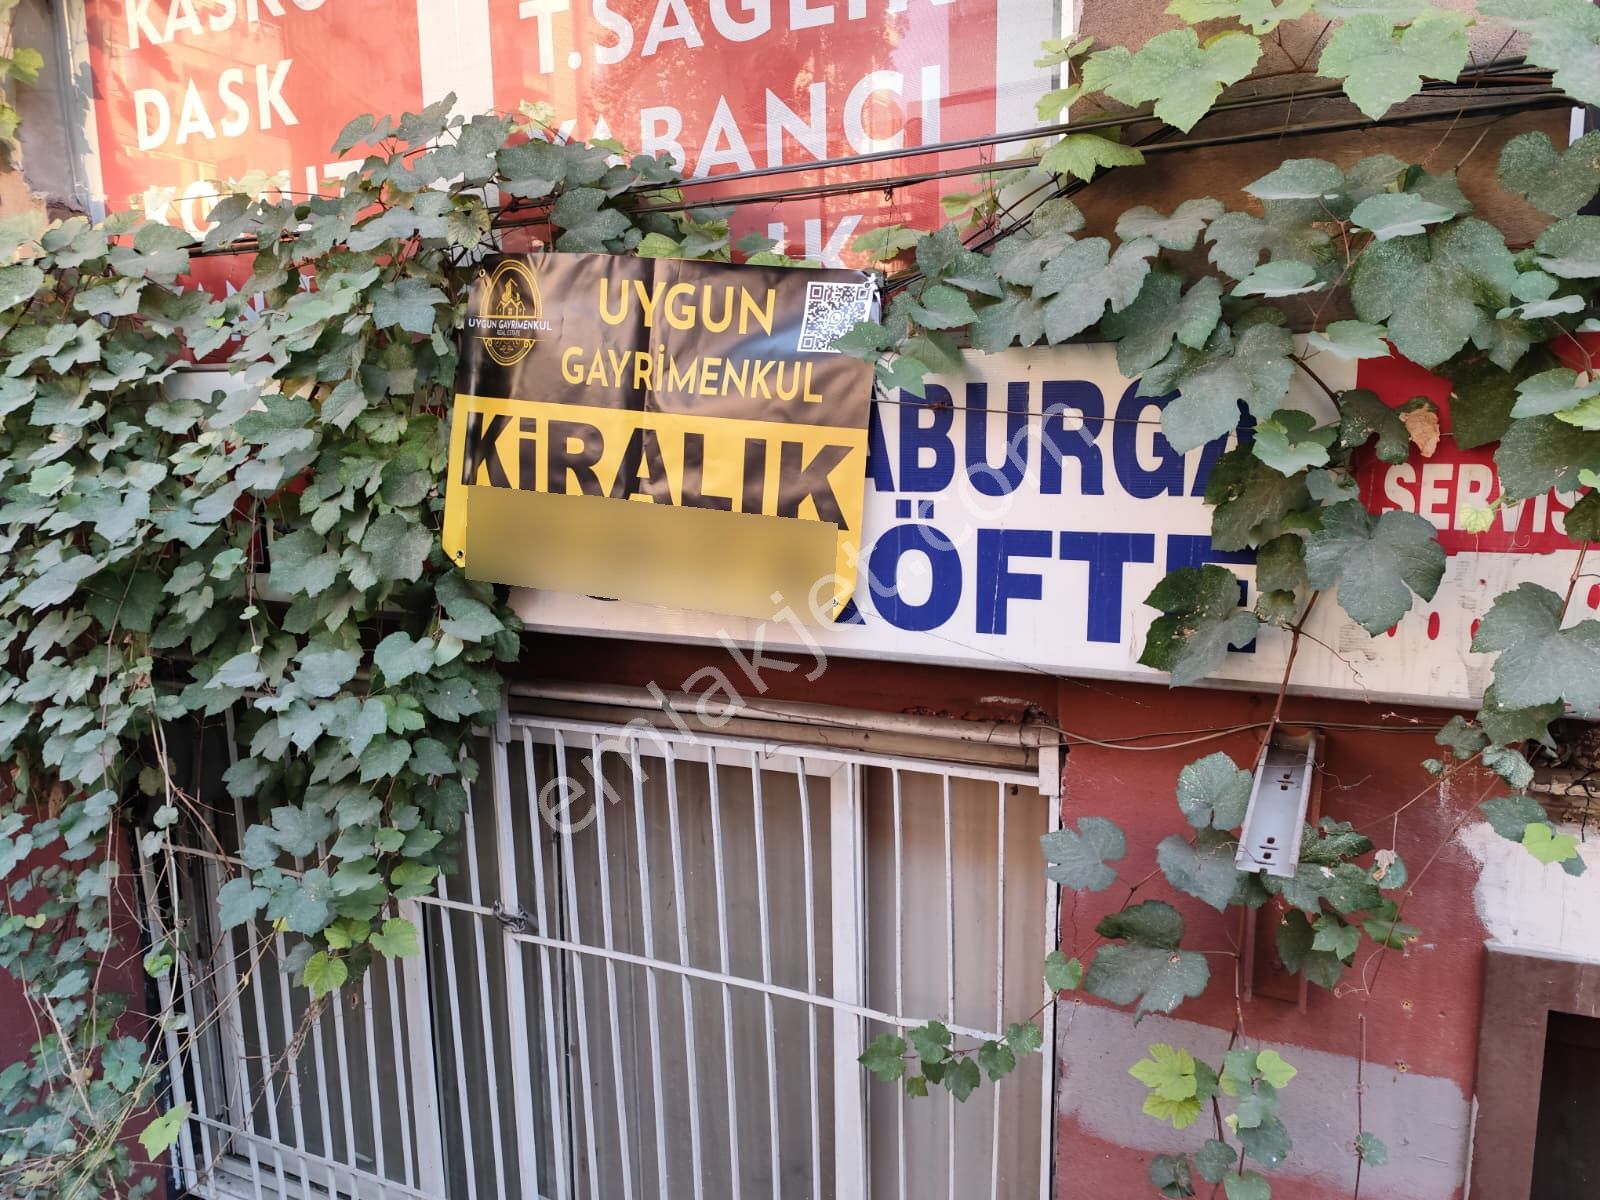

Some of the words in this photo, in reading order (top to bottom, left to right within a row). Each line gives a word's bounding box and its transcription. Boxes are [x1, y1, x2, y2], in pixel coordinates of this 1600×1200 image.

[134, 59, 298, 151] DASK
[468, 318, 497, 329] UYGUN
[600, 279, 776, 336] UYGUN
[561, 344, 823, 403] GAYRİMENKUL
